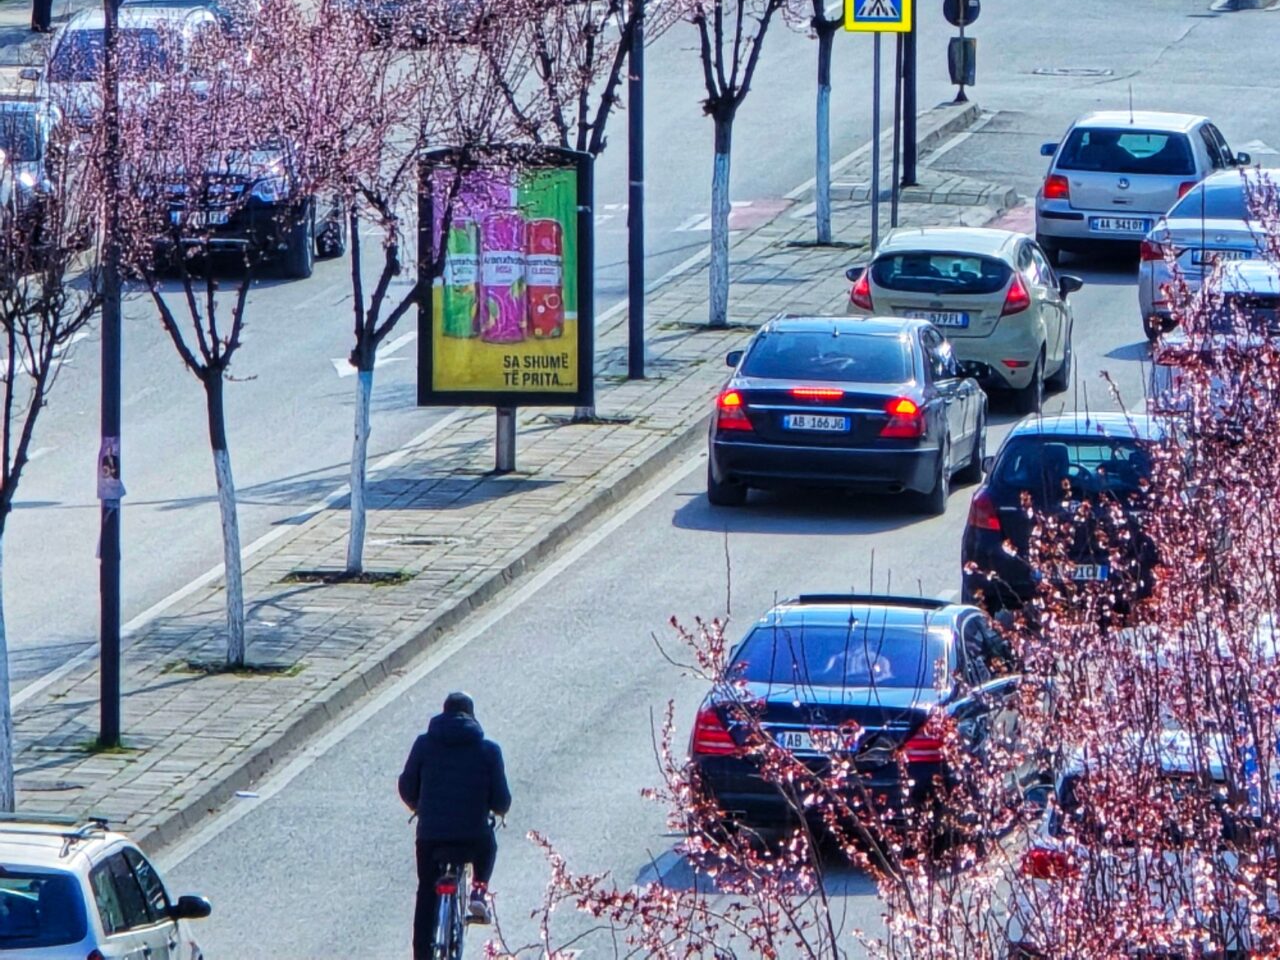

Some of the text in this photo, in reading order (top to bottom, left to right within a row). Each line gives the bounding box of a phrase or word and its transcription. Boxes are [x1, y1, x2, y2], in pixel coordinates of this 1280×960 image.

[1100, 219, 1111, 228] AA
[503, 352, 569, 369] SA SHUMË
[503, 370, 519, 386] TË
[791, 416, 805, 427] AB
[787, 734, 802, 747] AB
